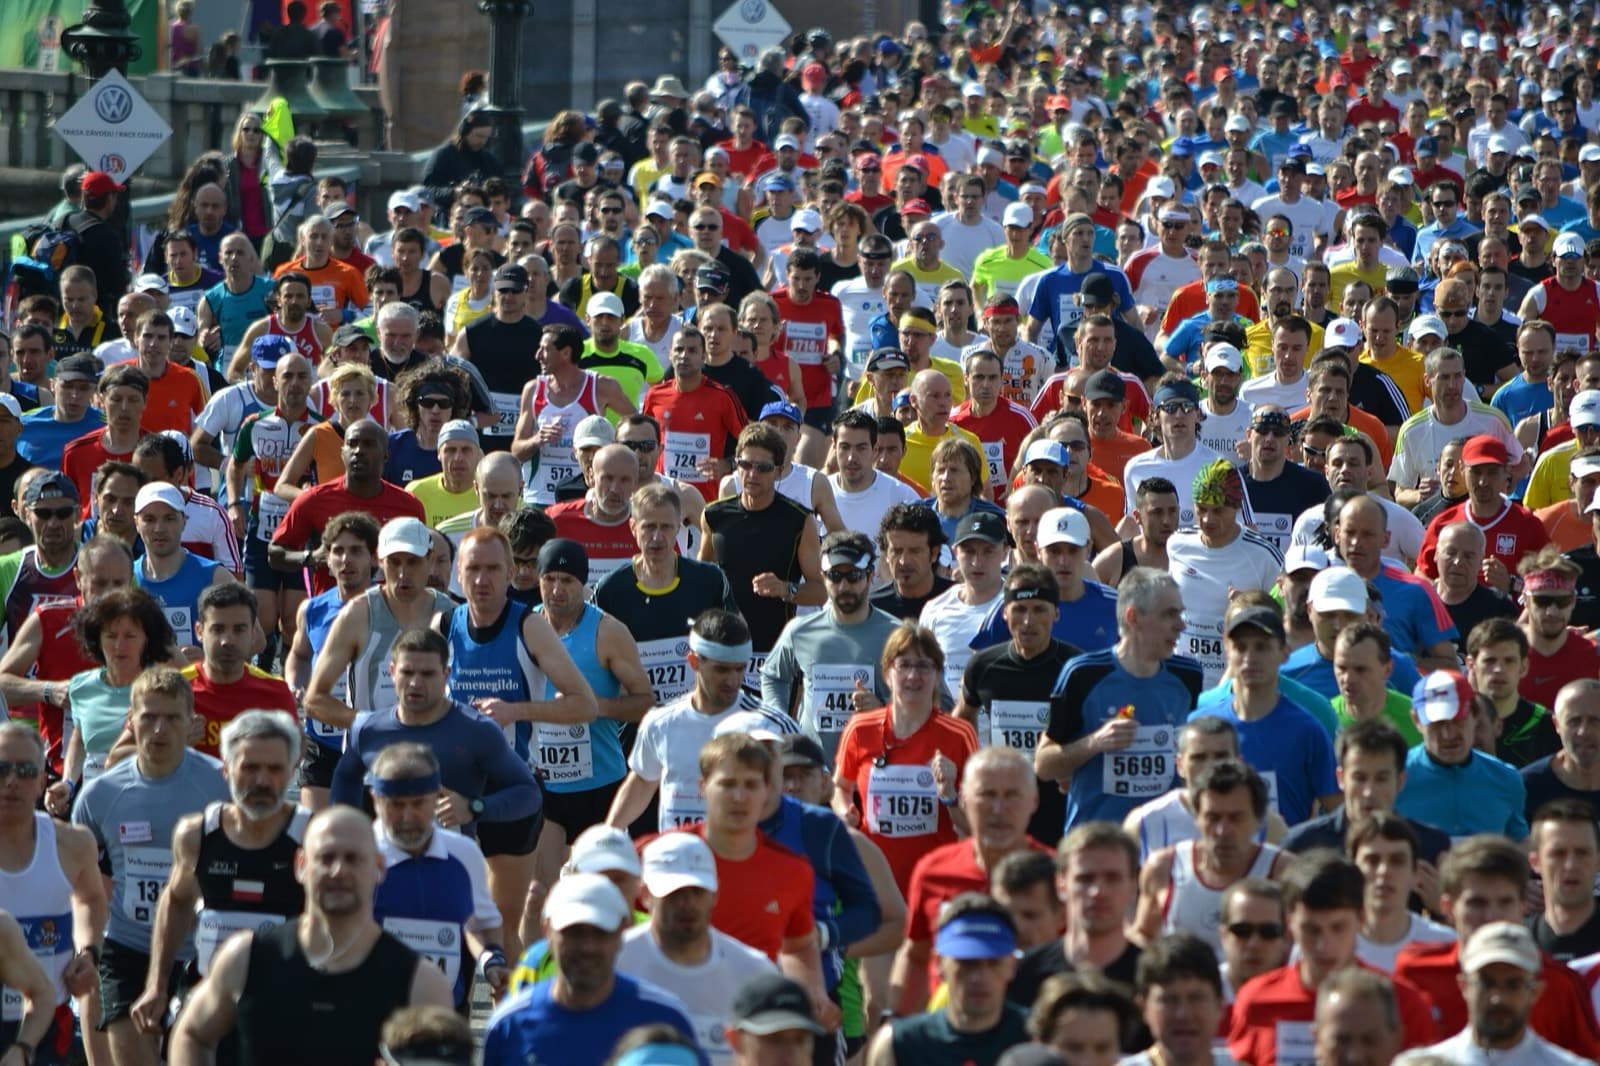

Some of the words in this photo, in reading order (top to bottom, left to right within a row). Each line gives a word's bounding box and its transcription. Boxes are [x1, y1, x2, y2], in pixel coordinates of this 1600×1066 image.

[137, 131, 163, 139] COURSE
[674, 454, 697, 468] 724
[551, 467, 573, 480] 573
[1190, 637, 1223, 656] 954
[457, 667, 482, 677] Gruppo
[647, 664, 687, 686] 1227
[815, 673, 852, 682] Volkswagen
[450, 679, 519, 692] Ermenegildo
[993, 711, 1035, 720] Volkswagen
[539, 745, 580, 765] 1021
[1113, 754, 1166, 777] 5699
[552, 769, 583, 779] boost
[1132, 784, 1162, 793] boost
[873, 795, 882, 816] F
[888, 795, 934, 816] 1675
[896, 822, 927, 833] boost
